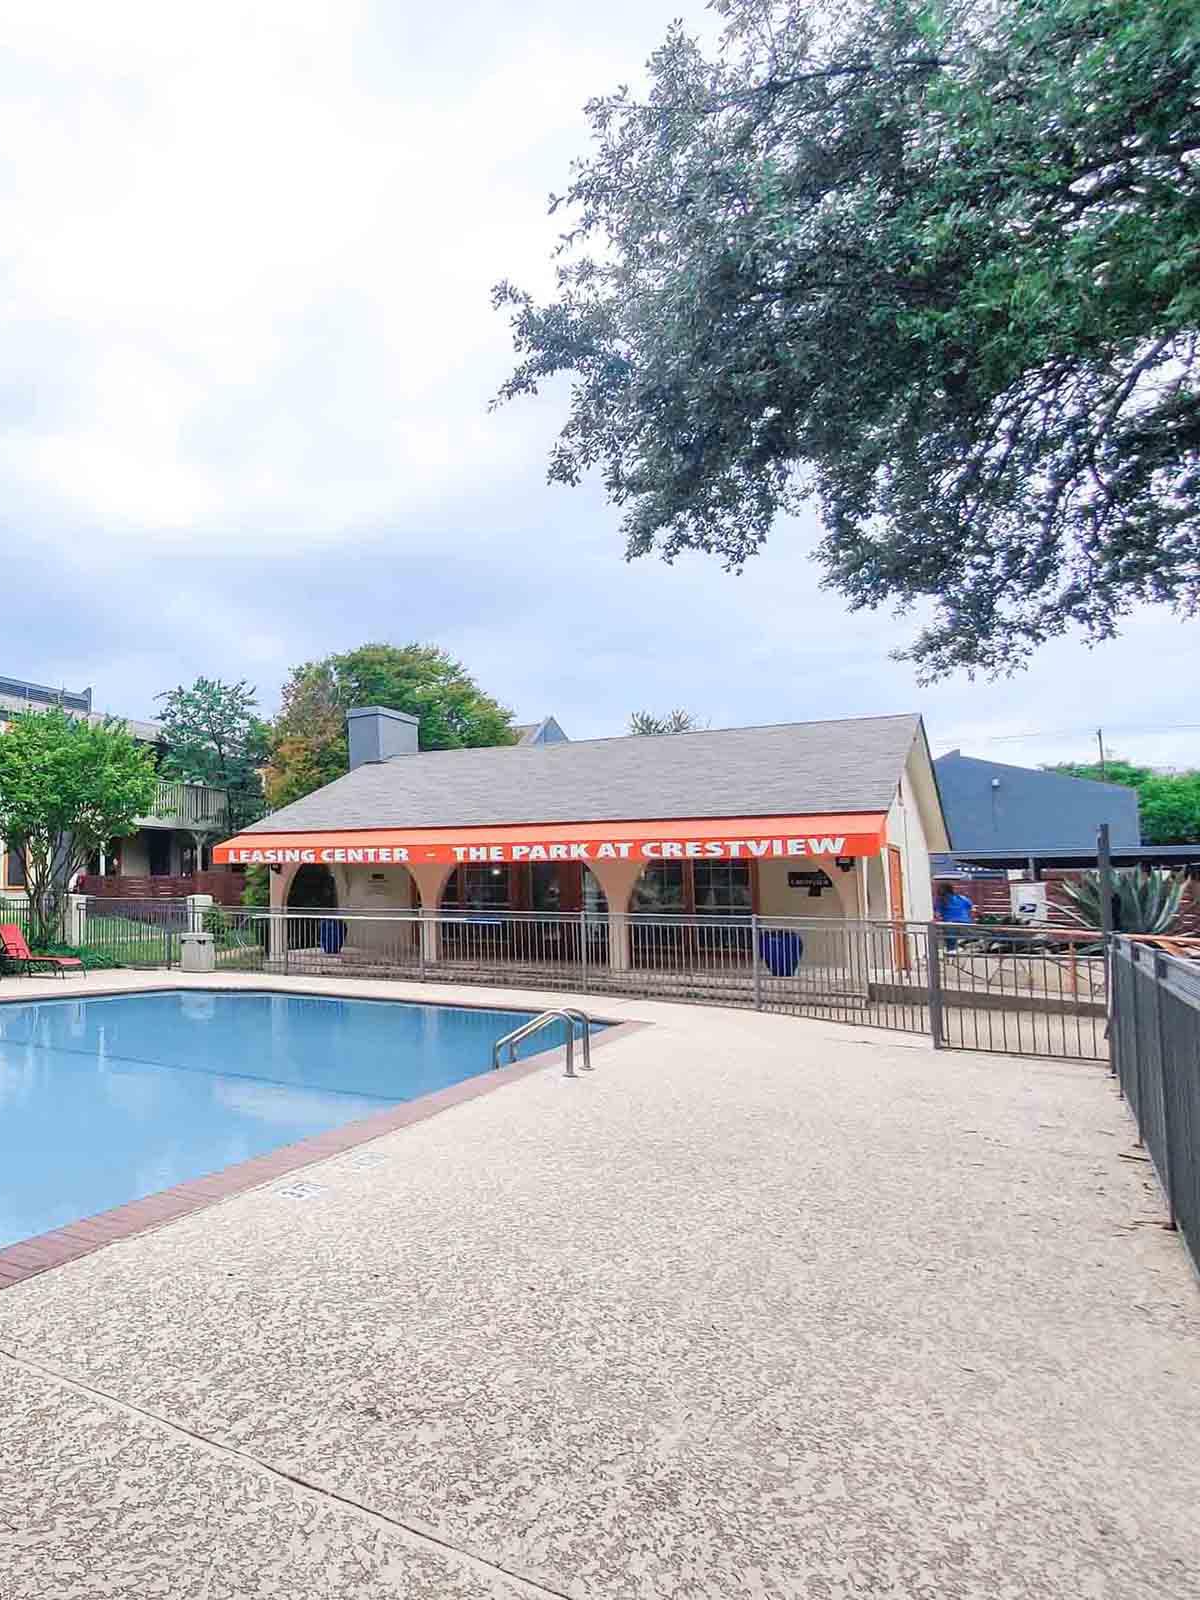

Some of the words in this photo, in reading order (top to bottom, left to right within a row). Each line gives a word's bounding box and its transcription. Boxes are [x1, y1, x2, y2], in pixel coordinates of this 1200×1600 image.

[228, 849, 315, 864] LEASING
[320, 847, 409, 863] CENTER
[452, 846, 505, 861] THE
[512, 843, 591, 860] PARK
[597, 842, 635, 858] AT
[641, 837, 846, 857] CRESTVIEW
